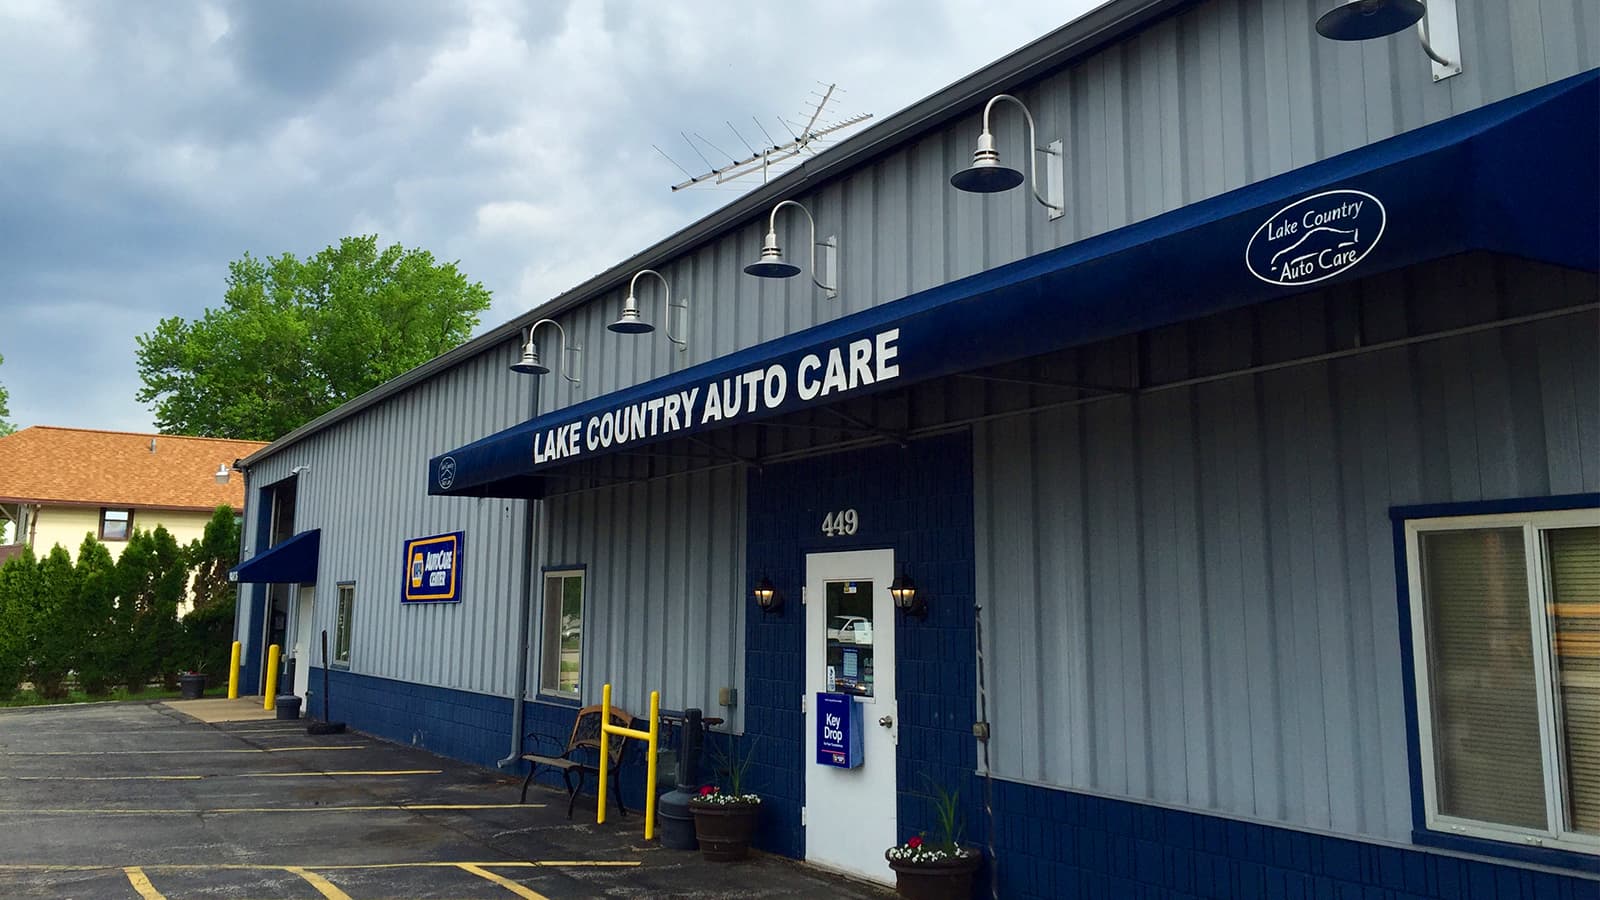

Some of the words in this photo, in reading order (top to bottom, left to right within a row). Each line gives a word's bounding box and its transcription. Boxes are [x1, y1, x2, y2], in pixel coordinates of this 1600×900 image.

[1268, 219, 1298, 241] Lake
[1303, 201, 1363, 228] Country
[1280, 261, 1314, 281] Auto
[1319, 248, 1357, 269] Care
[534, 421, 582, 464] LAKE
[586, 387, 699, 451] COUNTRY
[701, 364, 787, 424] AUTO
[797, 328, 900, 400] CARE
[822, 509, 858, 537] 449
[824, 726, 843, 743] Drop
[826, 713, 841, 730] Key
